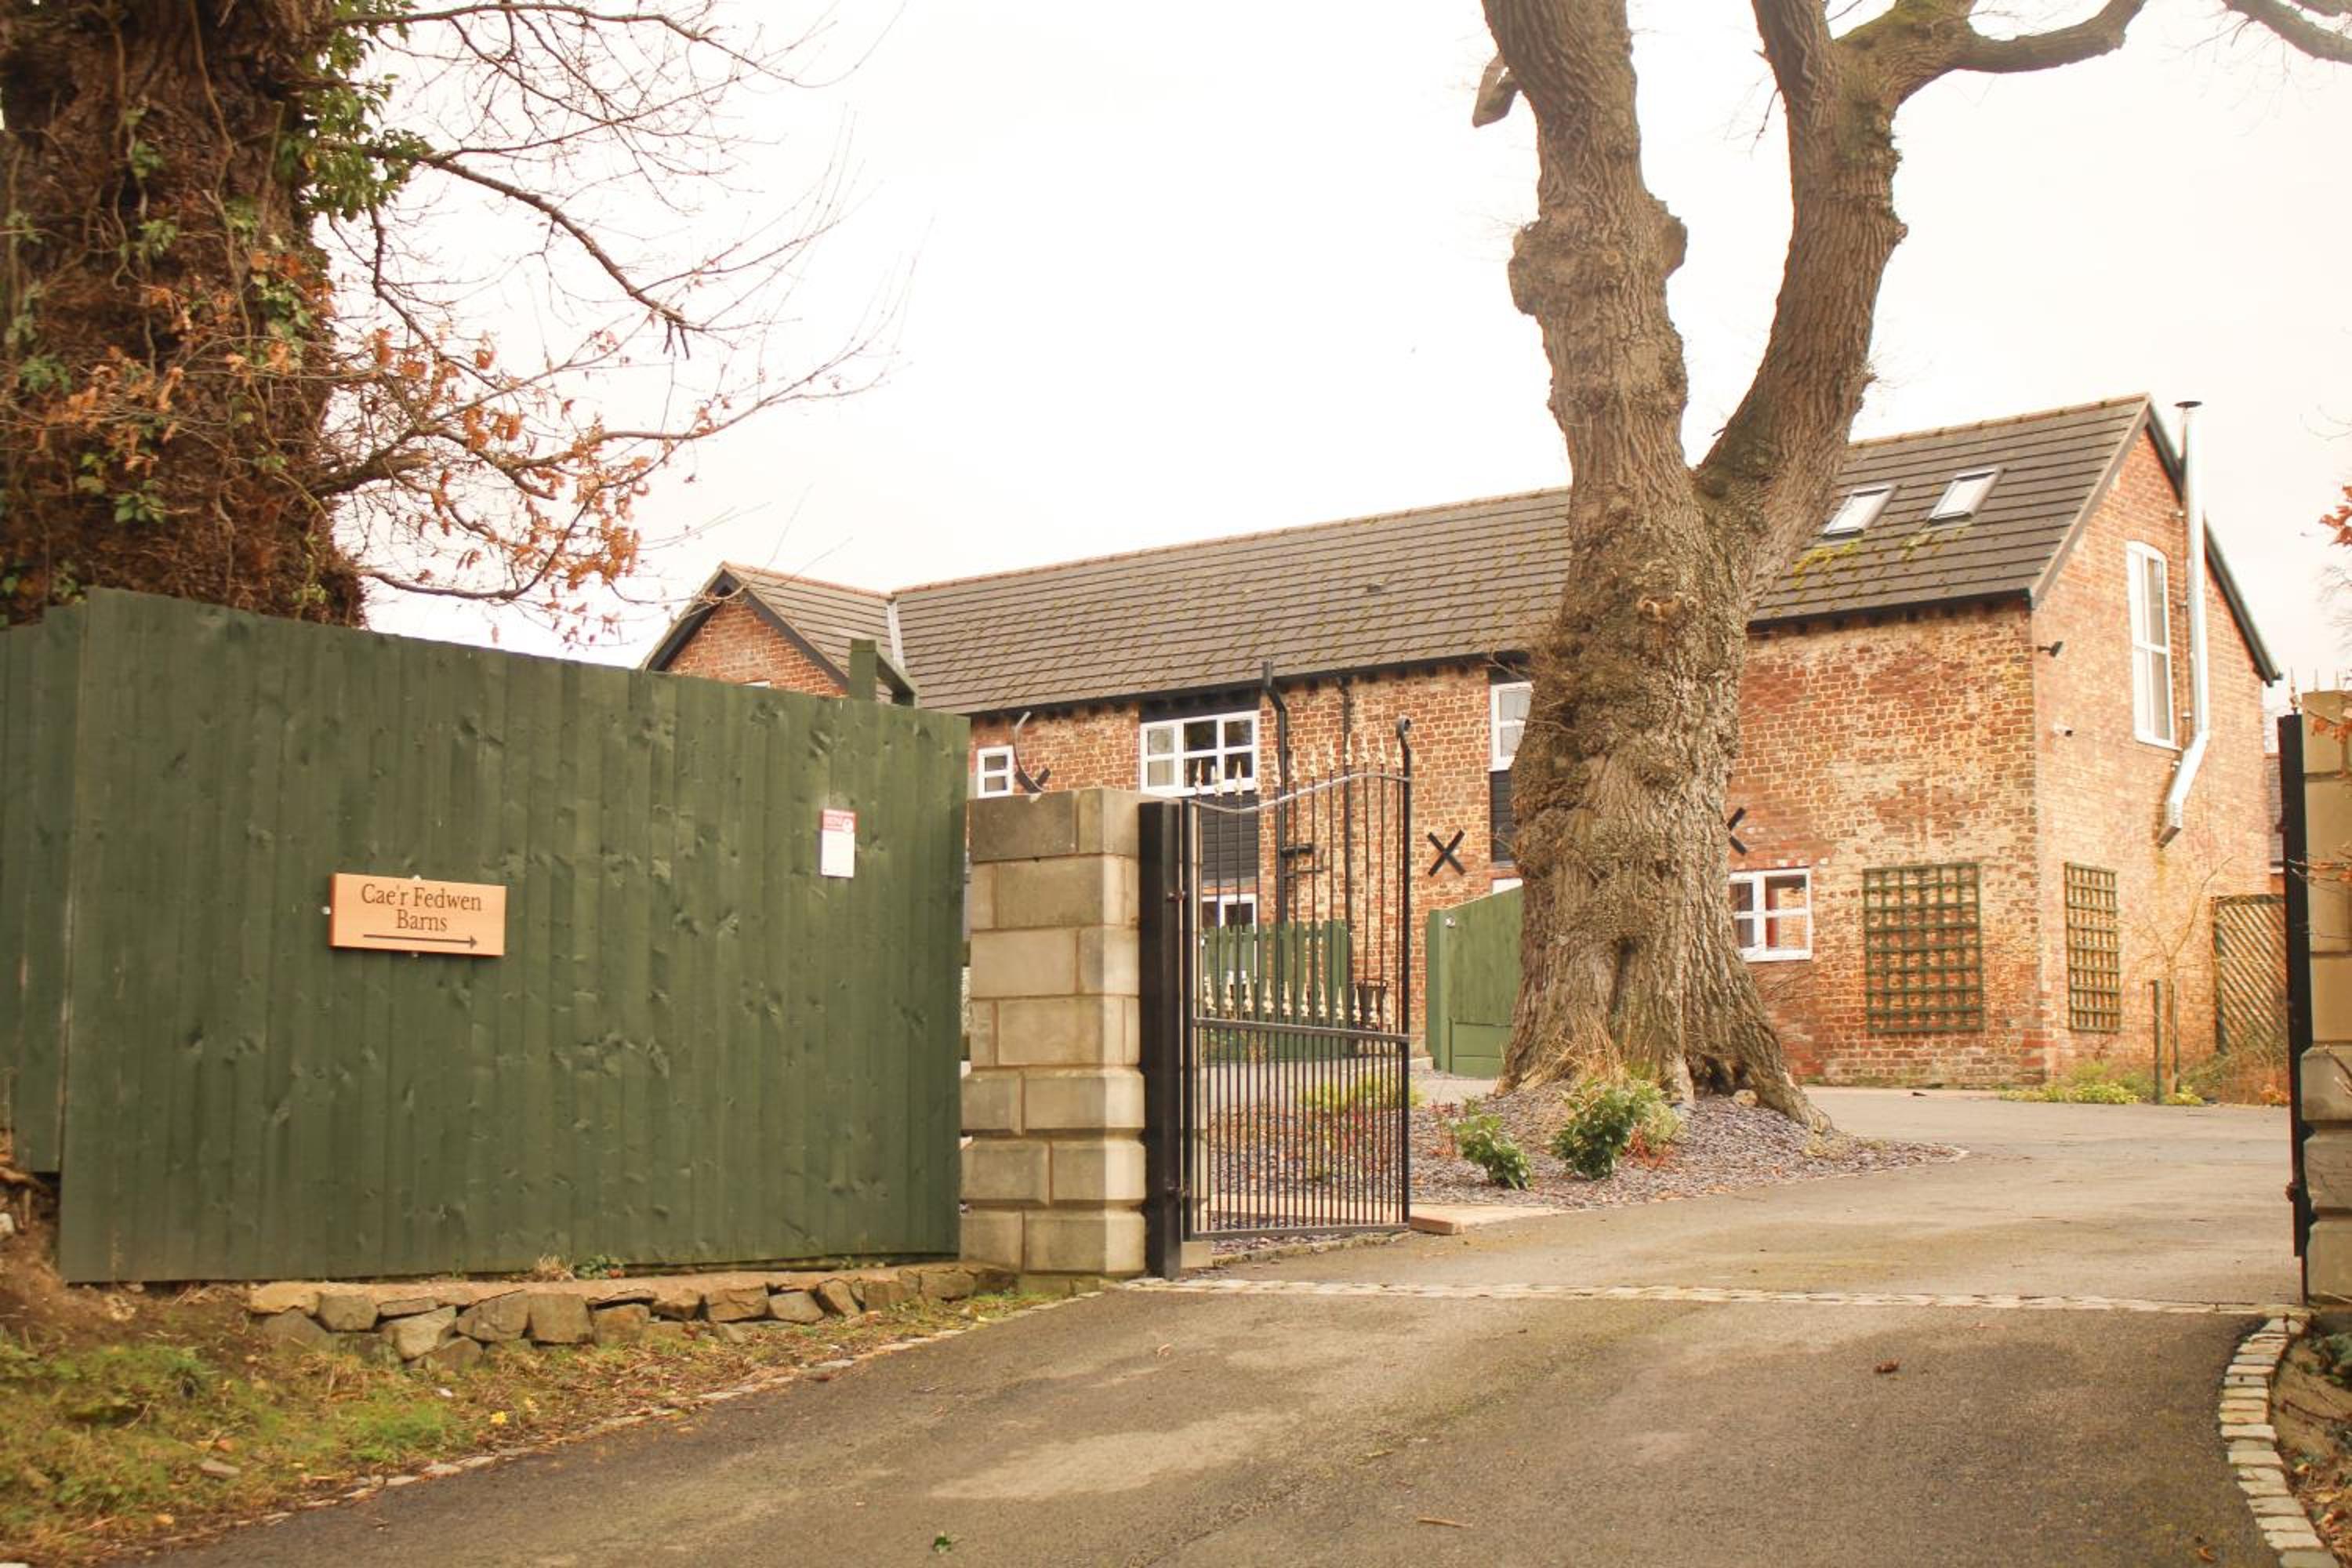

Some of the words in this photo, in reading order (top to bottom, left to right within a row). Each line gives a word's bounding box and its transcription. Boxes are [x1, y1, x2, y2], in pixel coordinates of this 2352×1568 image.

[361, 884, 408, 905] Cae'r
[414, 887, 482, 912] Fedwen
[396, 909, 448, 931] Barns
